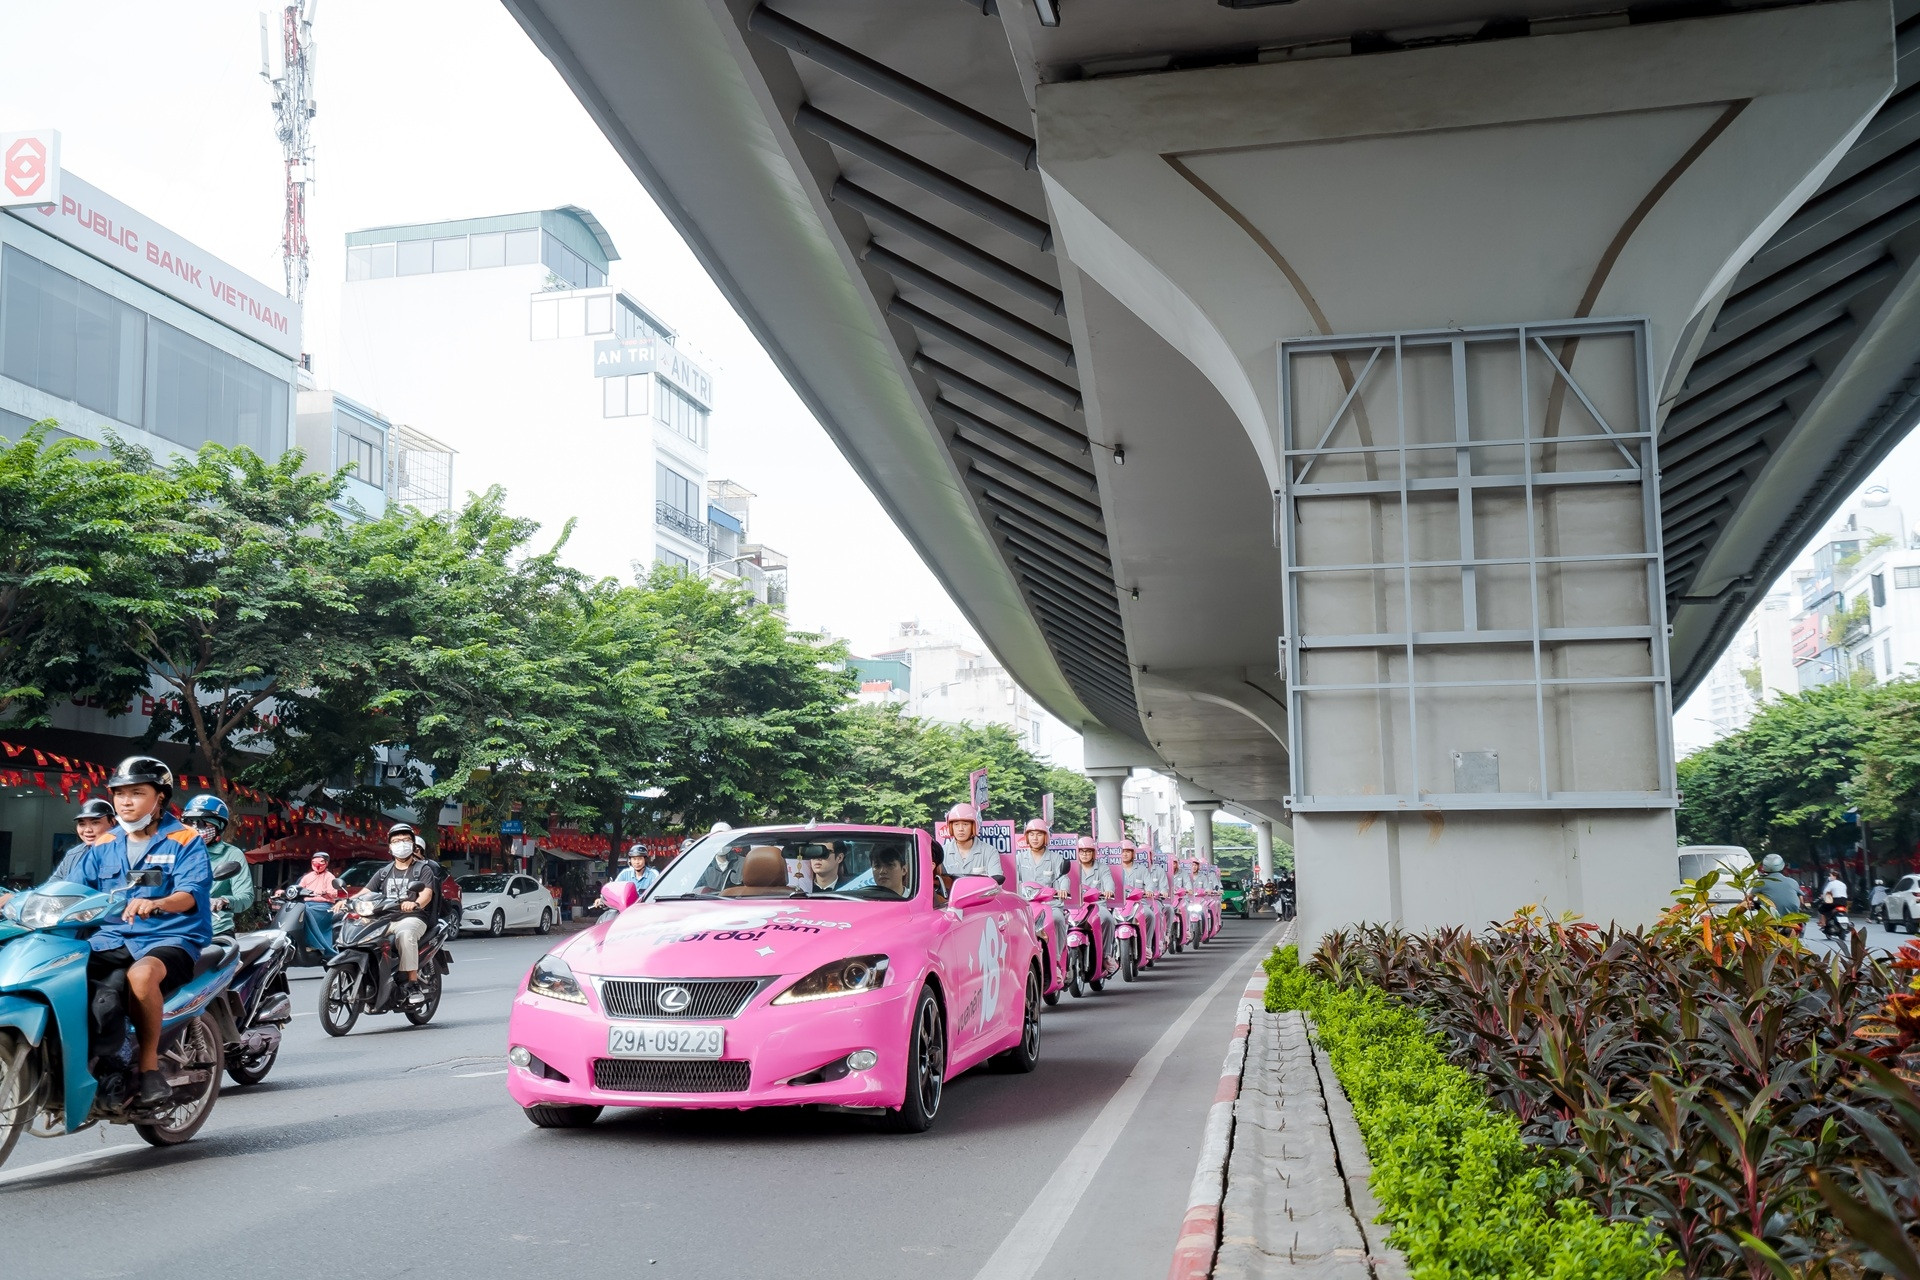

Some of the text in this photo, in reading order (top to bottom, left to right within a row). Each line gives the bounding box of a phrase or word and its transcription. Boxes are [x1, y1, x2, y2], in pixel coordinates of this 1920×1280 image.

[62, 194, 288, 335] PUBLIC BANK VIETNAM
[597, 347, 655, 365] AN TRI
[671, 355, 712, 404] AN TRI
[612, 1029, 720, 1053] 29A-092.29
